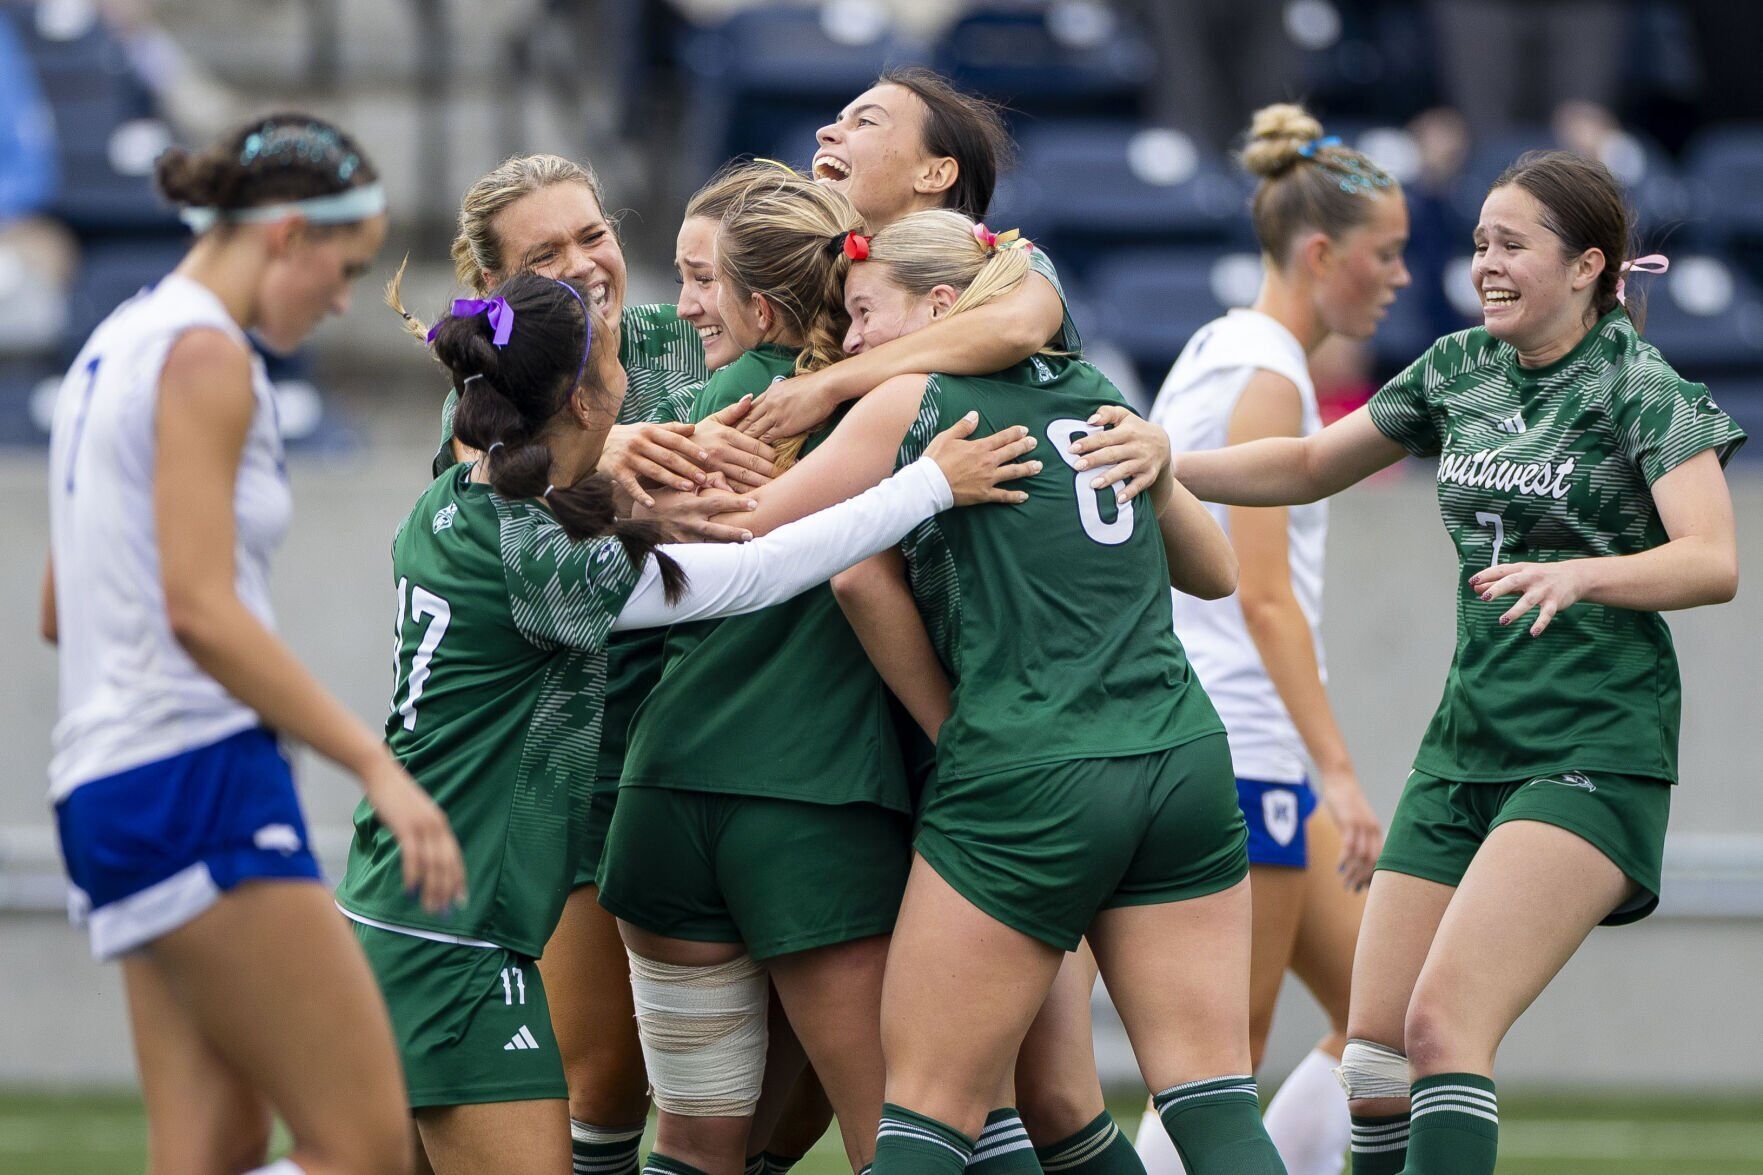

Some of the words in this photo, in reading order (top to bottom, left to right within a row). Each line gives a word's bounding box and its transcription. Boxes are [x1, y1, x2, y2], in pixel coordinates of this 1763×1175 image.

[1046, 418, 1134, 546] 8
[1475, 511, 1504, 568] 7
[500, 967, 525, 1005] 17
